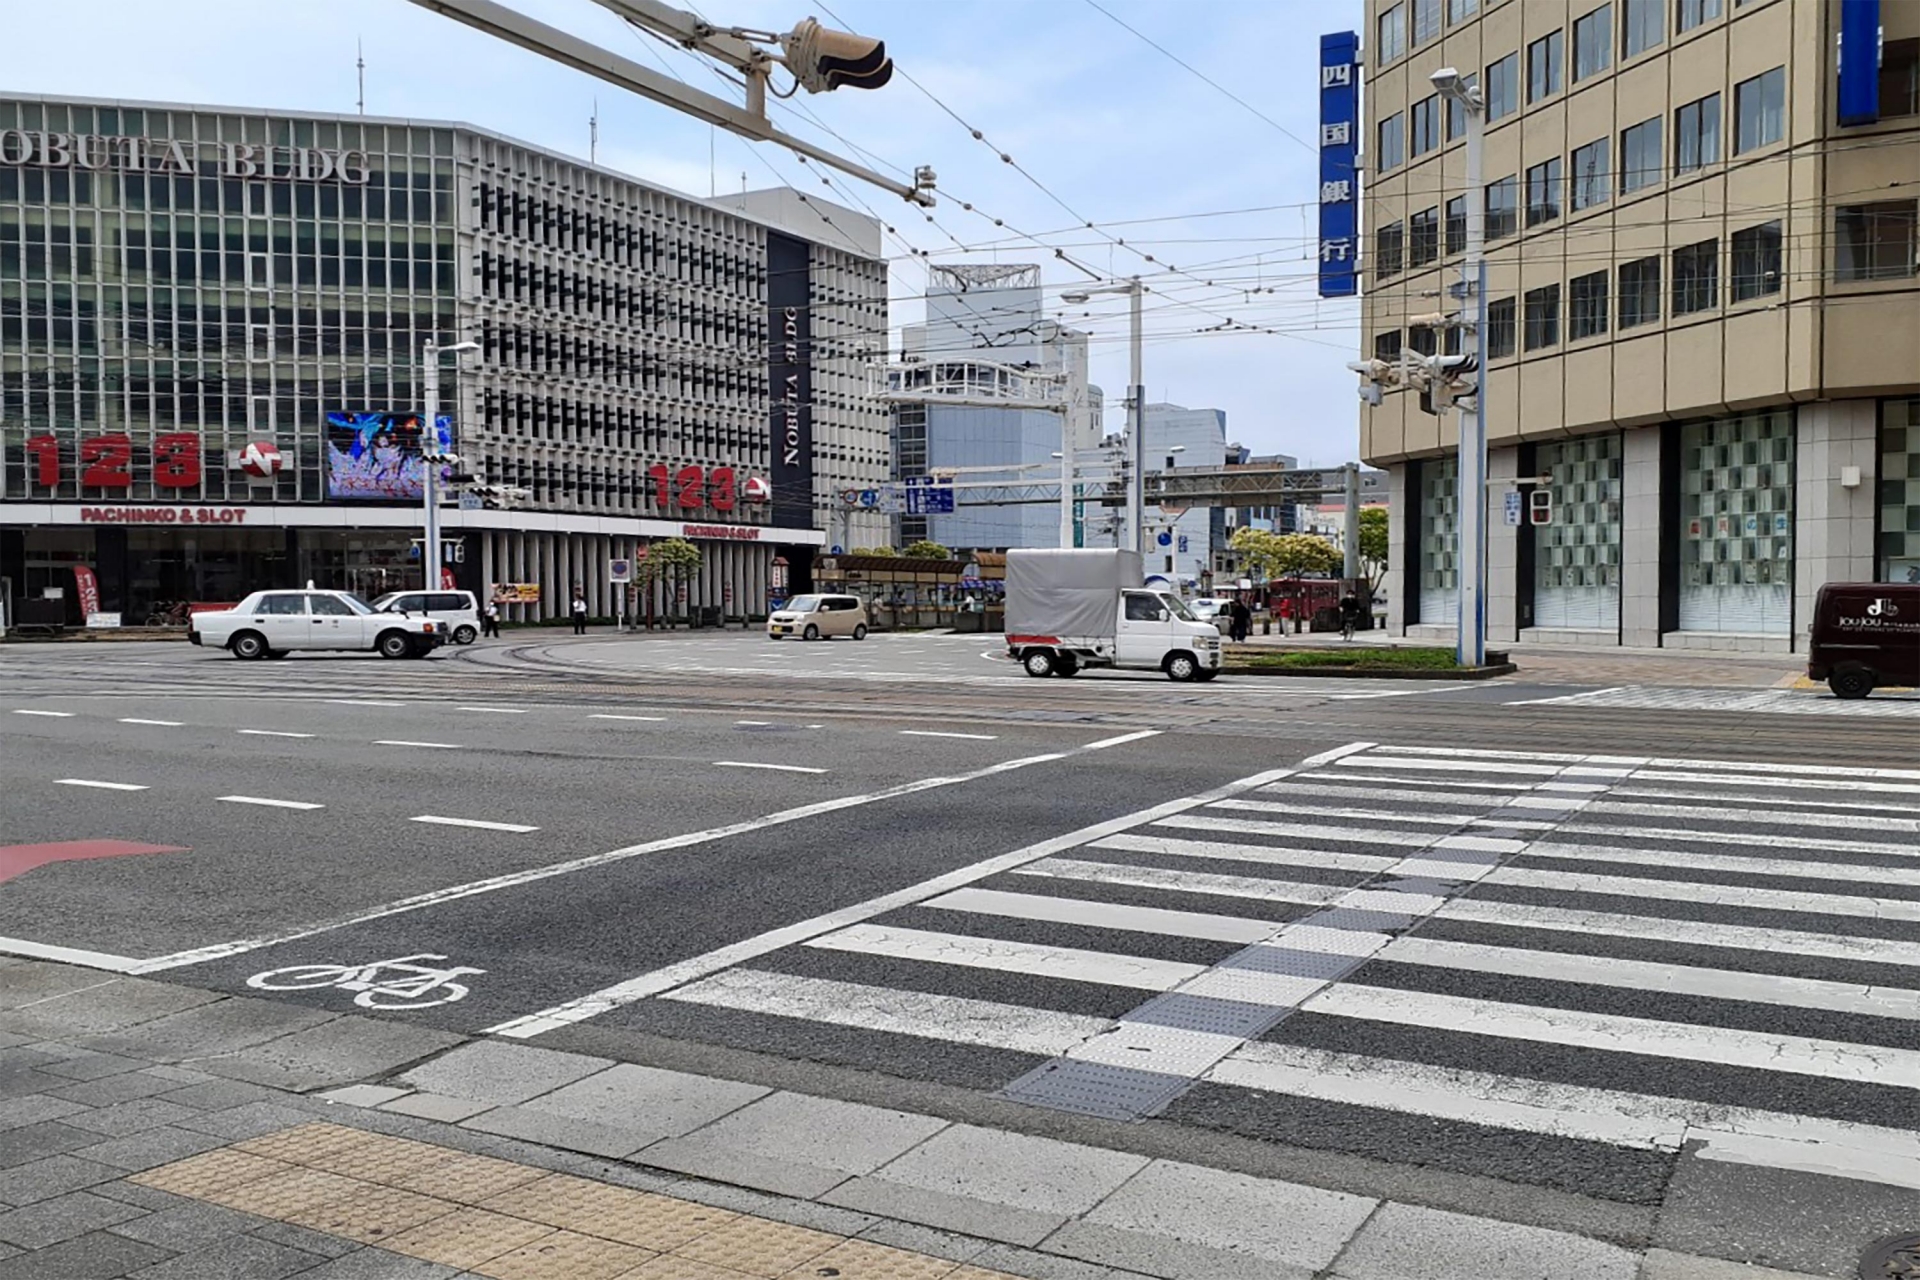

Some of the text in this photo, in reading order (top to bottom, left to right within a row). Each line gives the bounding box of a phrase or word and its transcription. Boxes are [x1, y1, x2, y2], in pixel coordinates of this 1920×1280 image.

[223, 141, 371, 185] BLDG
[1321, 63, 1350, 262] 四国銀行
[784, 306, 799, 467] NOBUTA BLDG
[27, 433, 200, 487] 123
[649, 465, 735, 511] 123
[81, 507, 246, 524] PACHINKO & SLOT
